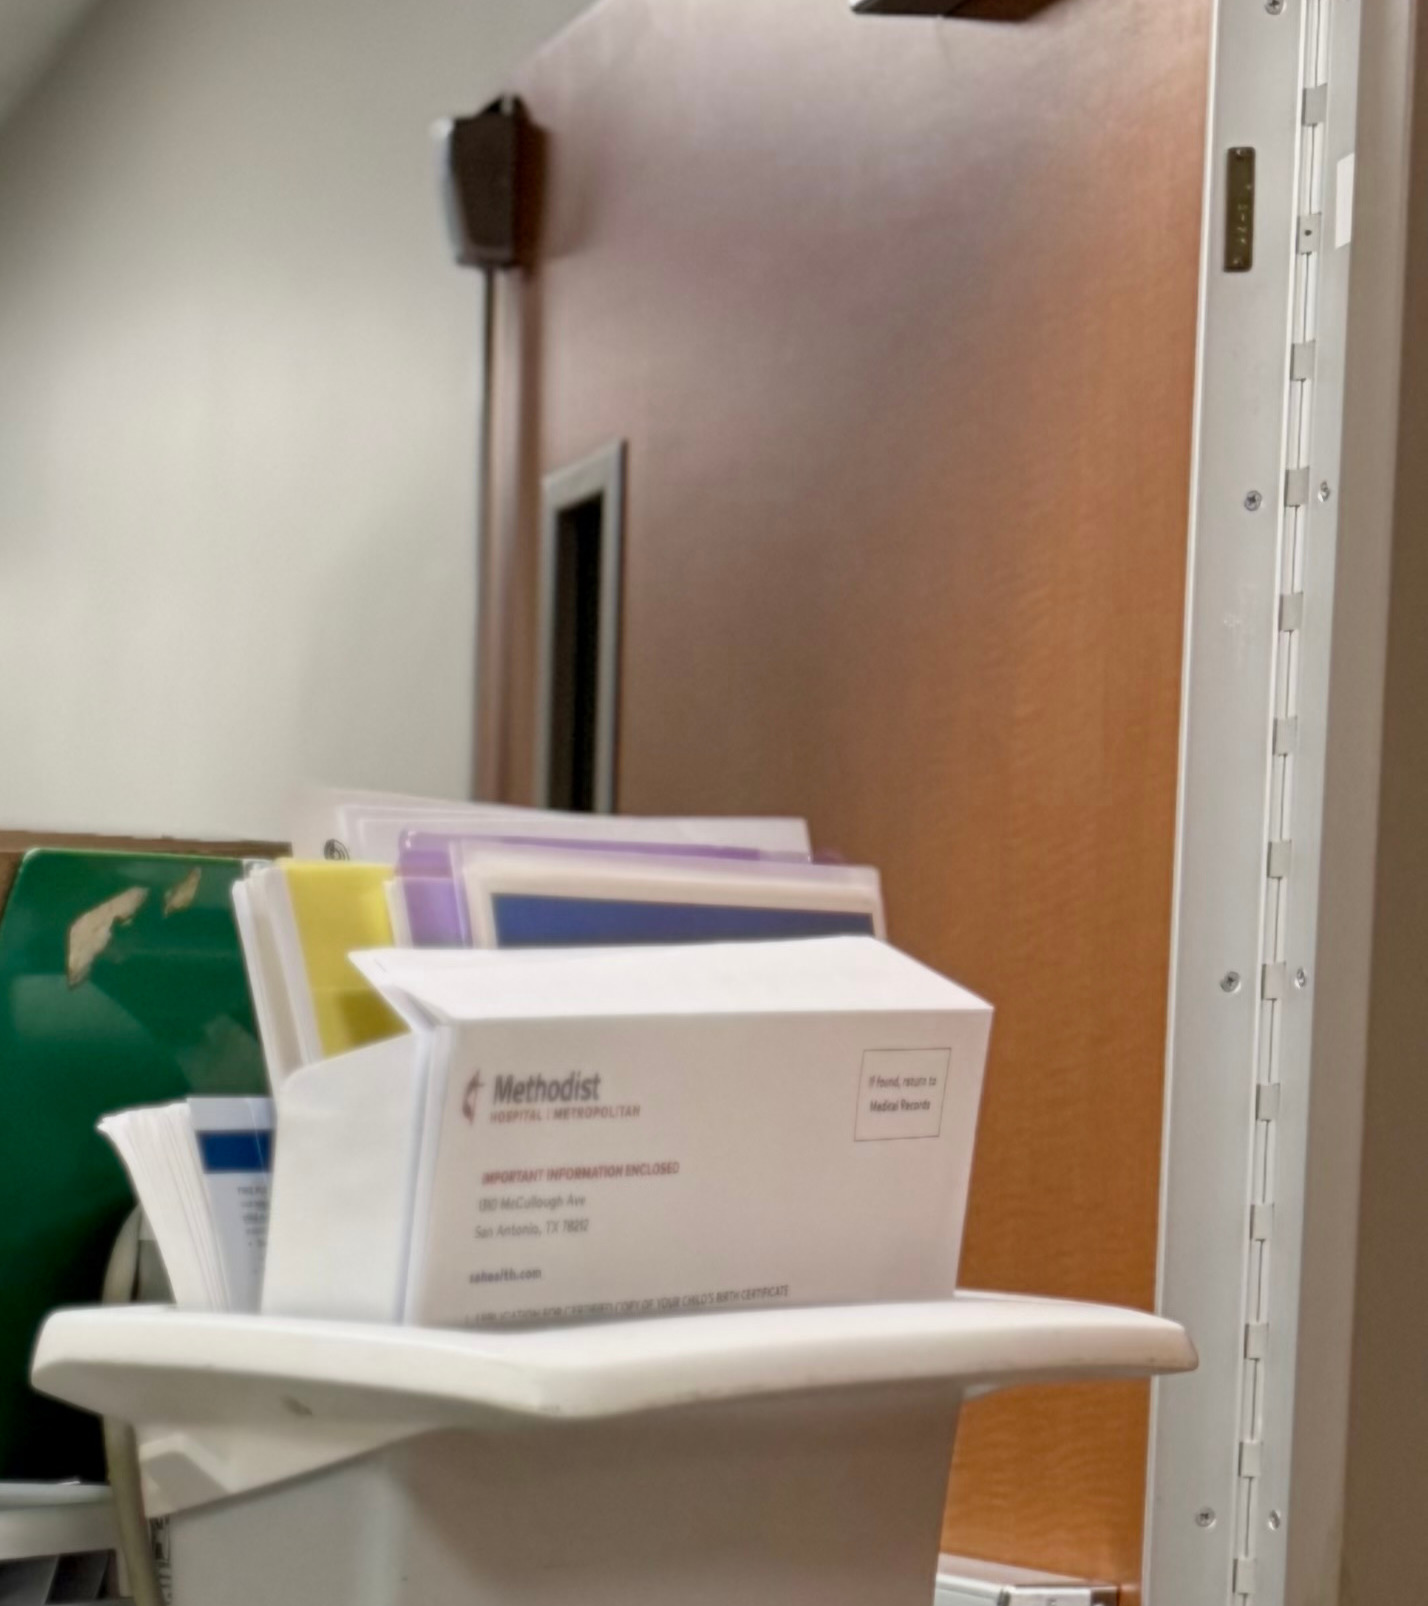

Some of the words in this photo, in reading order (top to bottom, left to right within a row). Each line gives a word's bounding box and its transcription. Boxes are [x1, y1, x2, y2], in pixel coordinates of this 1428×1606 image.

[493, 1070, 601, 1105] Methodist
[490, 1108, 543, 1124] HOSPITAL
[553, 1104, 641, 1121] METROPOLITAN
[870, 1099, 899, 1112] Medical
[900, 1099, 931, 1112] Records
[481, 1168, 544, 1187] IMPORTANT
[546, 1164, 624, 1182] INFORMATION
[625, 1160, 681, 1177] ENCLOSED
[566, 1193, 587, 1208] Ave
[475, 1224, 494, 1240] San
[496, 1221, 543, 1238] Antonio,
[545, 1219, 560, 1235] TX
